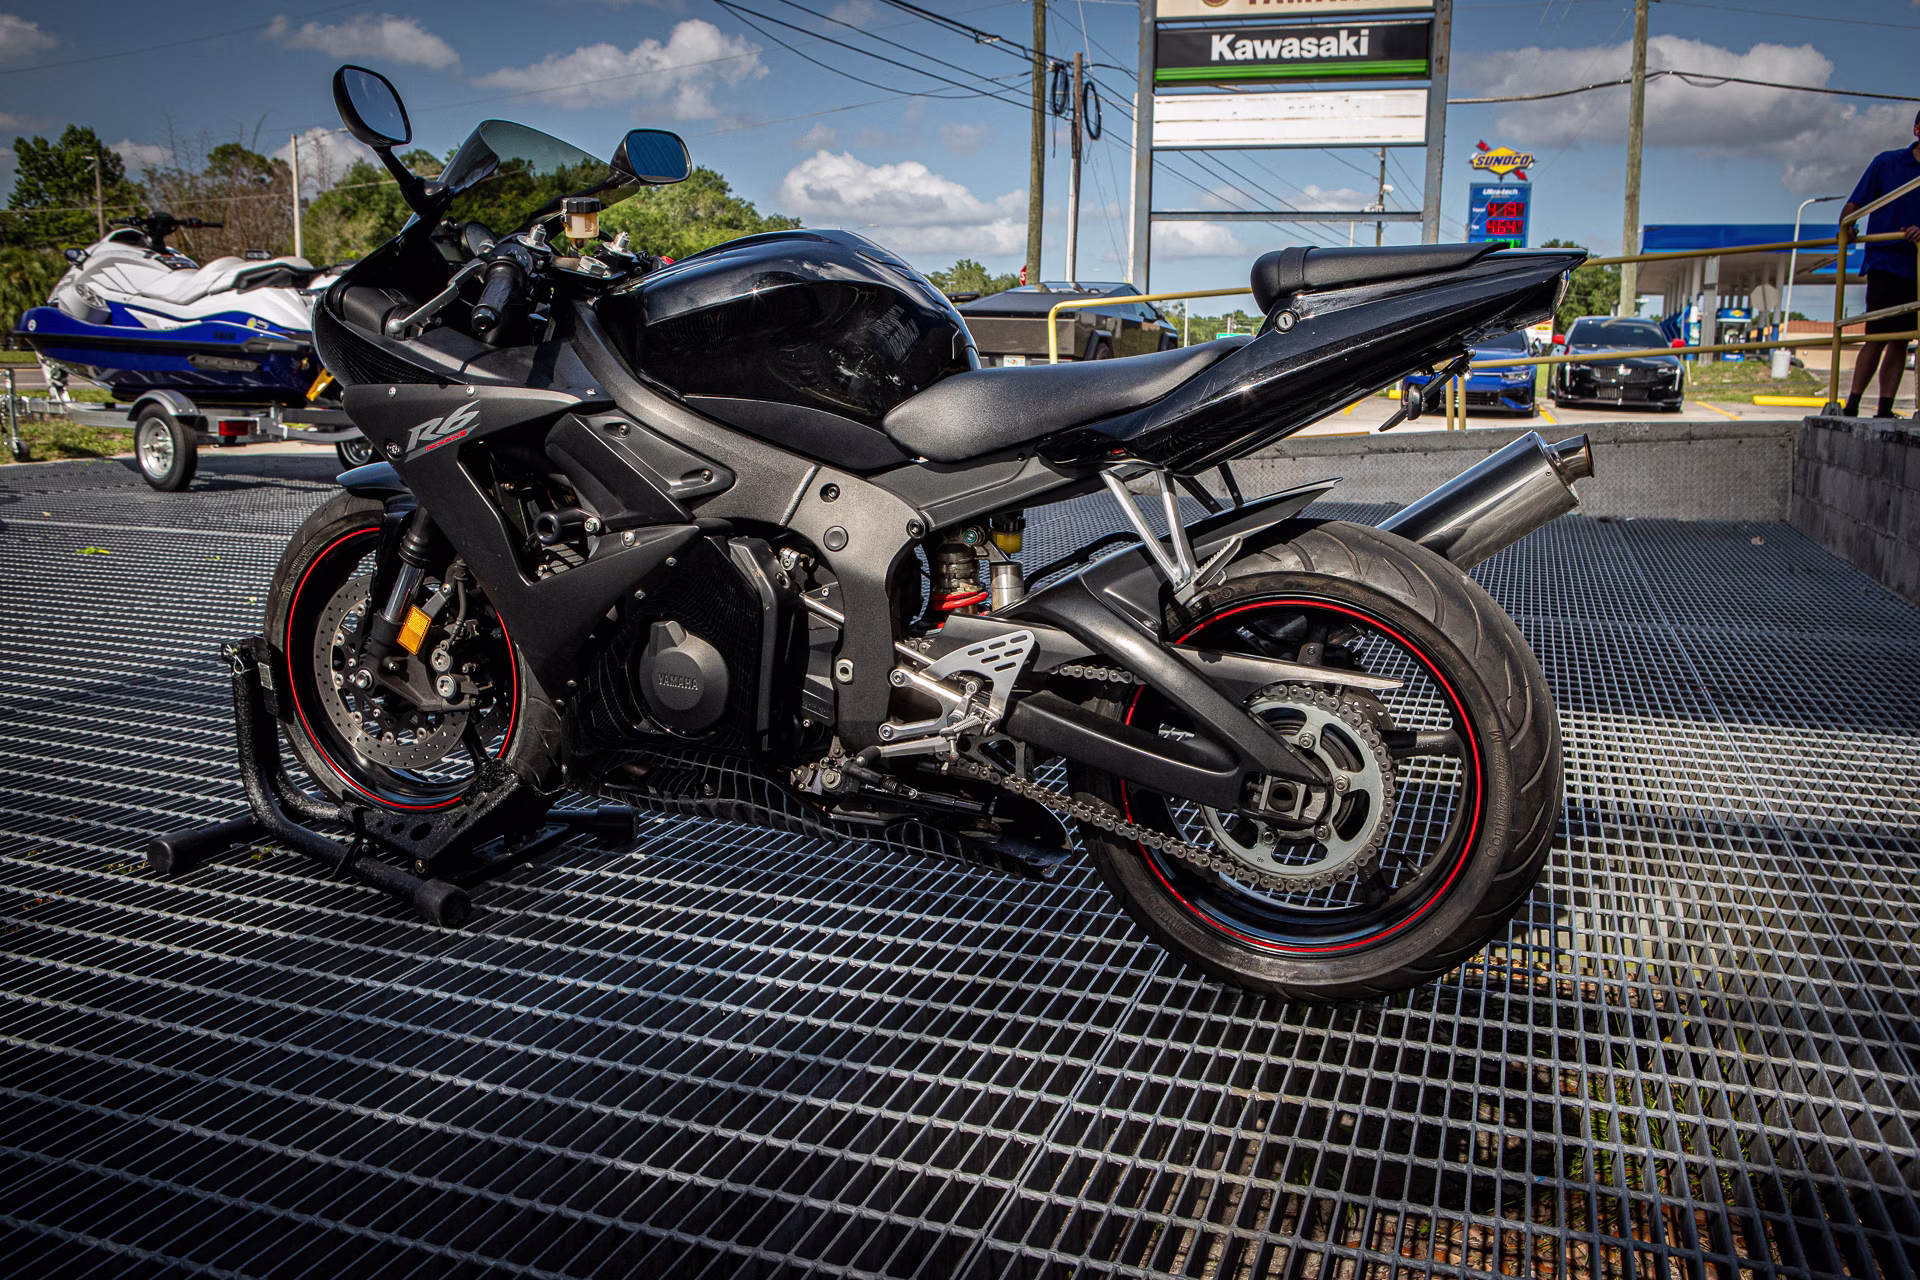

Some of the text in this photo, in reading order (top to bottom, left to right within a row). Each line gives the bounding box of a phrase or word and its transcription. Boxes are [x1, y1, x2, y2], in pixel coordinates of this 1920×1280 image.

[1211, 29, 1370, 61] Kawasaki
[1475, 155, 1530, 167] SUNOCO
[405, 399, 480, 453] R6
[658, 672, 699, 691] YAMAHA
